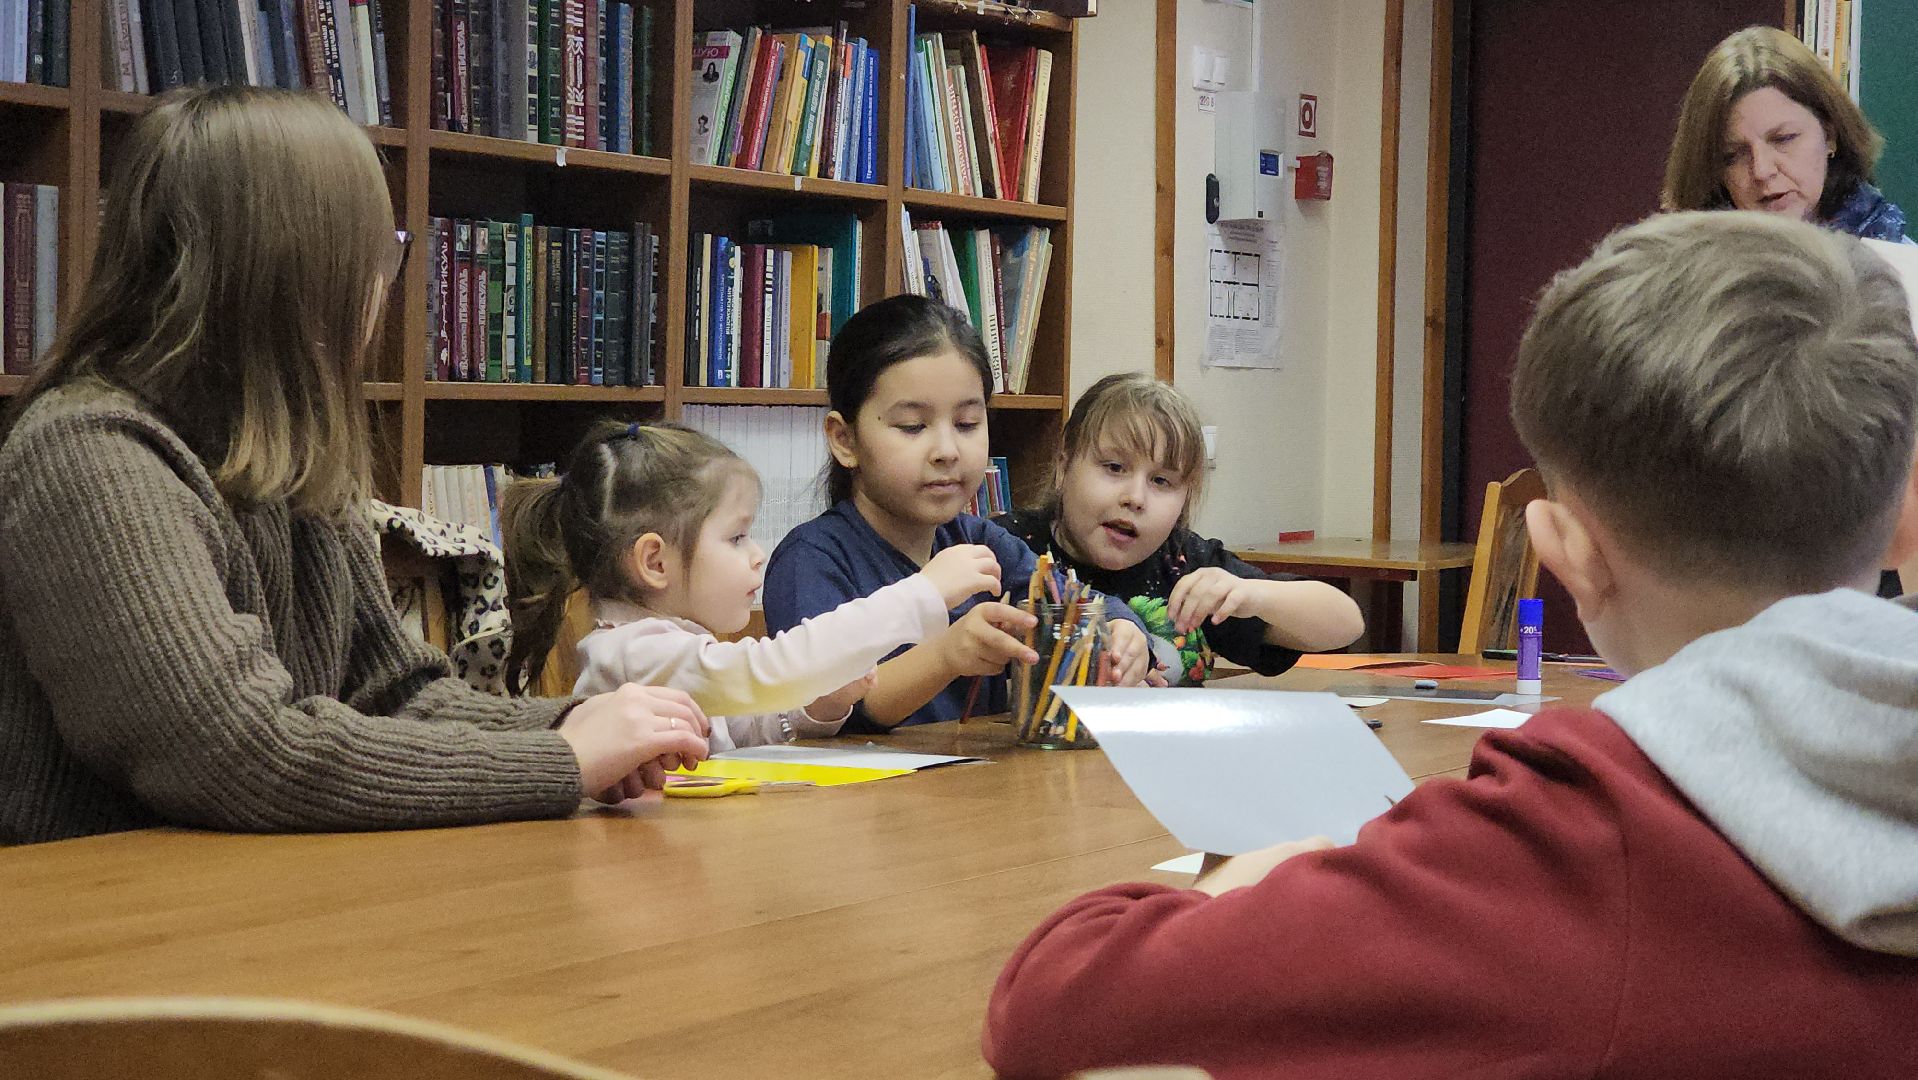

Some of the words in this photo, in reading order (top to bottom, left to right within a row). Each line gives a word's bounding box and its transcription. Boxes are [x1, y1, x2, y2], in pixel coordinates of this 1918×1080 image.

[457, 21, 467, 75] ПИКУЛЬ
[440, 241, 449, 294] ПИКУЛЬ
[459, 268, 469, 323] ПИКУЛЬ
[478, 270, 487, 325] ПИКУЛЬ
